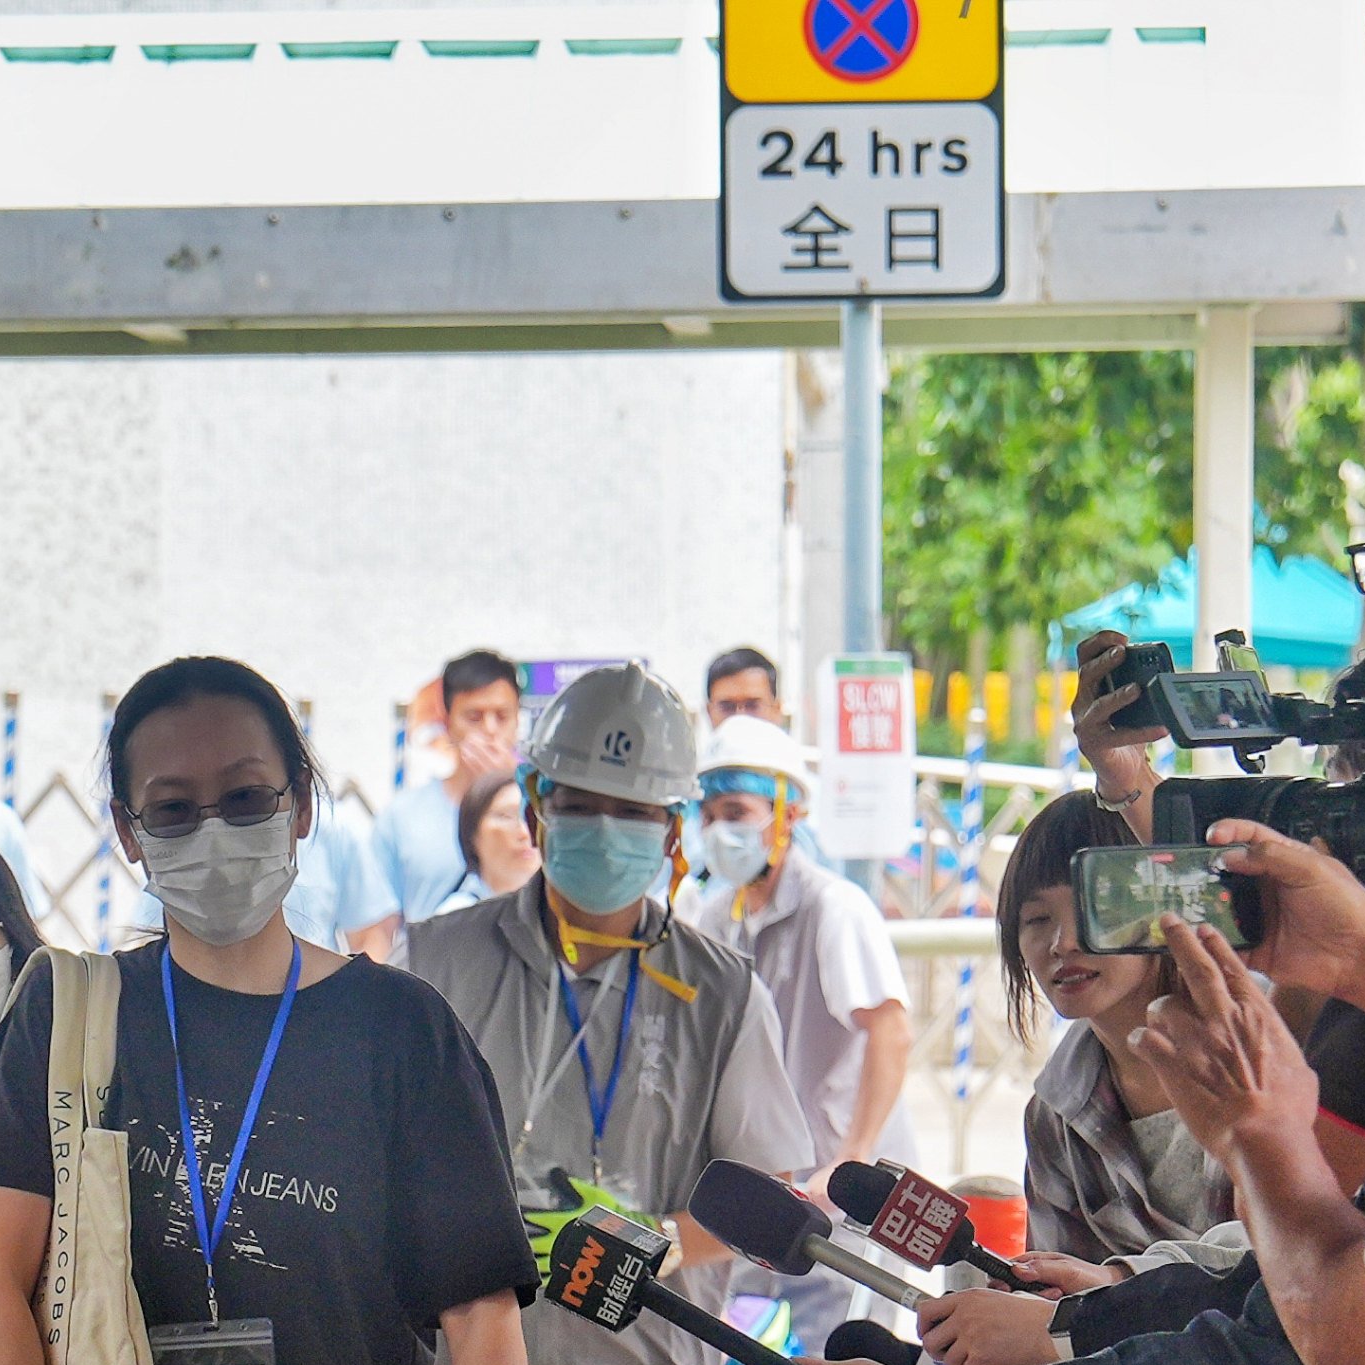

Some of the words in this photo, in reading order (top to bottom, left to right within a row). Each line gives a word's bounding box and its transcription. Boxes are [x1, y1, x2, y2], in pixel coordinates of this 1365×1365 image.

[759, 130, 843, 177] 24
[870, 129, 969, 175] hrs
[781, 204, 941, 270] 全日
[842, 682, 898, 713] SLOW
[52, 1090, 73, 1185] MARC
[250, 1170, 339, 1213] JEANS
[878, 1180, 933, 1245] 巴士
[47, 1202, 71, 1346] JACOBS
[561, 1234, 606, 1309] now
